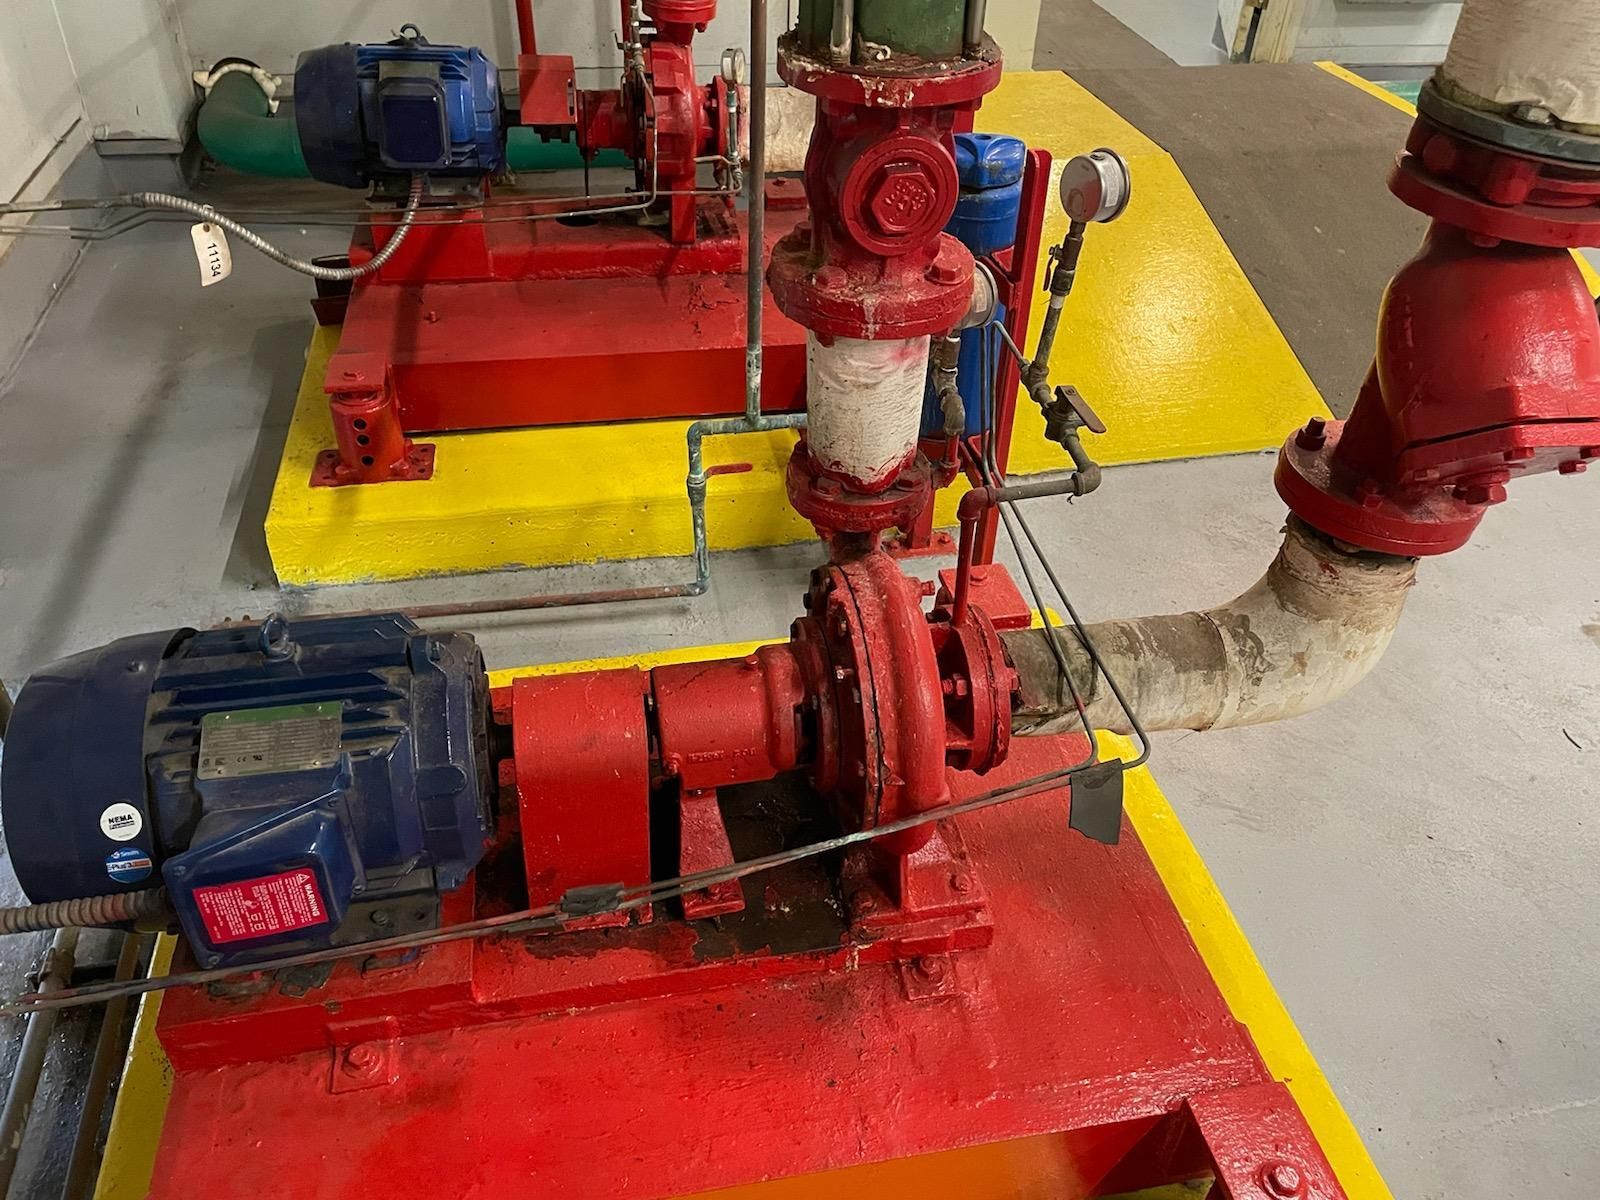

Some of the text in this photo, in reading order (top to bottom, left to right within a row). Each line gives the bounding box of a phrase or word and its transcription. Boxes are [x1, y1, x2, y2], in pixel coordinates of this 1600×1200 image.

[207, 243, 221, 277] 11134
[108, 814, 133, 824] NEMA
[303, 883, 321, 916] WARNING
